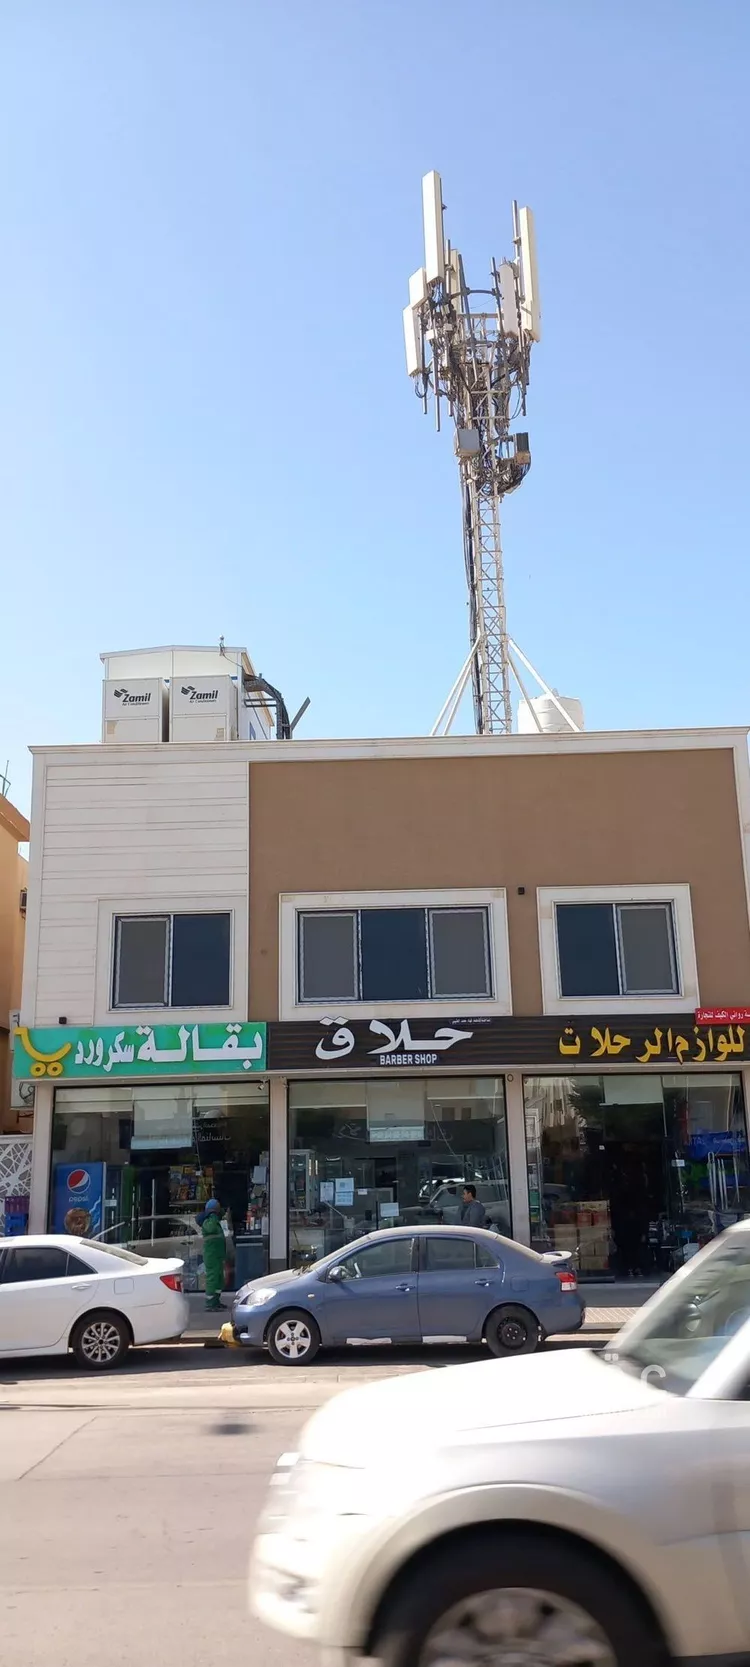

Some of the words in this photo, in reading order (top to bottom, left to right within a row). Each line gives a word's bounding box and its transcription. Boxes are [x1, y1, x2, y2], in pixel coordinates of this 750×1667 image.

[122, 693, 151, 702] Zamil
[190, 691, 219, 700] Zamil
[137, 1023, 263, 1070] بقالة
[674, 1024, 746, 1065] للوازم
[379, 1054, 413, 1066] BARBER
[414, 1053, 438, 1064] SHOP
